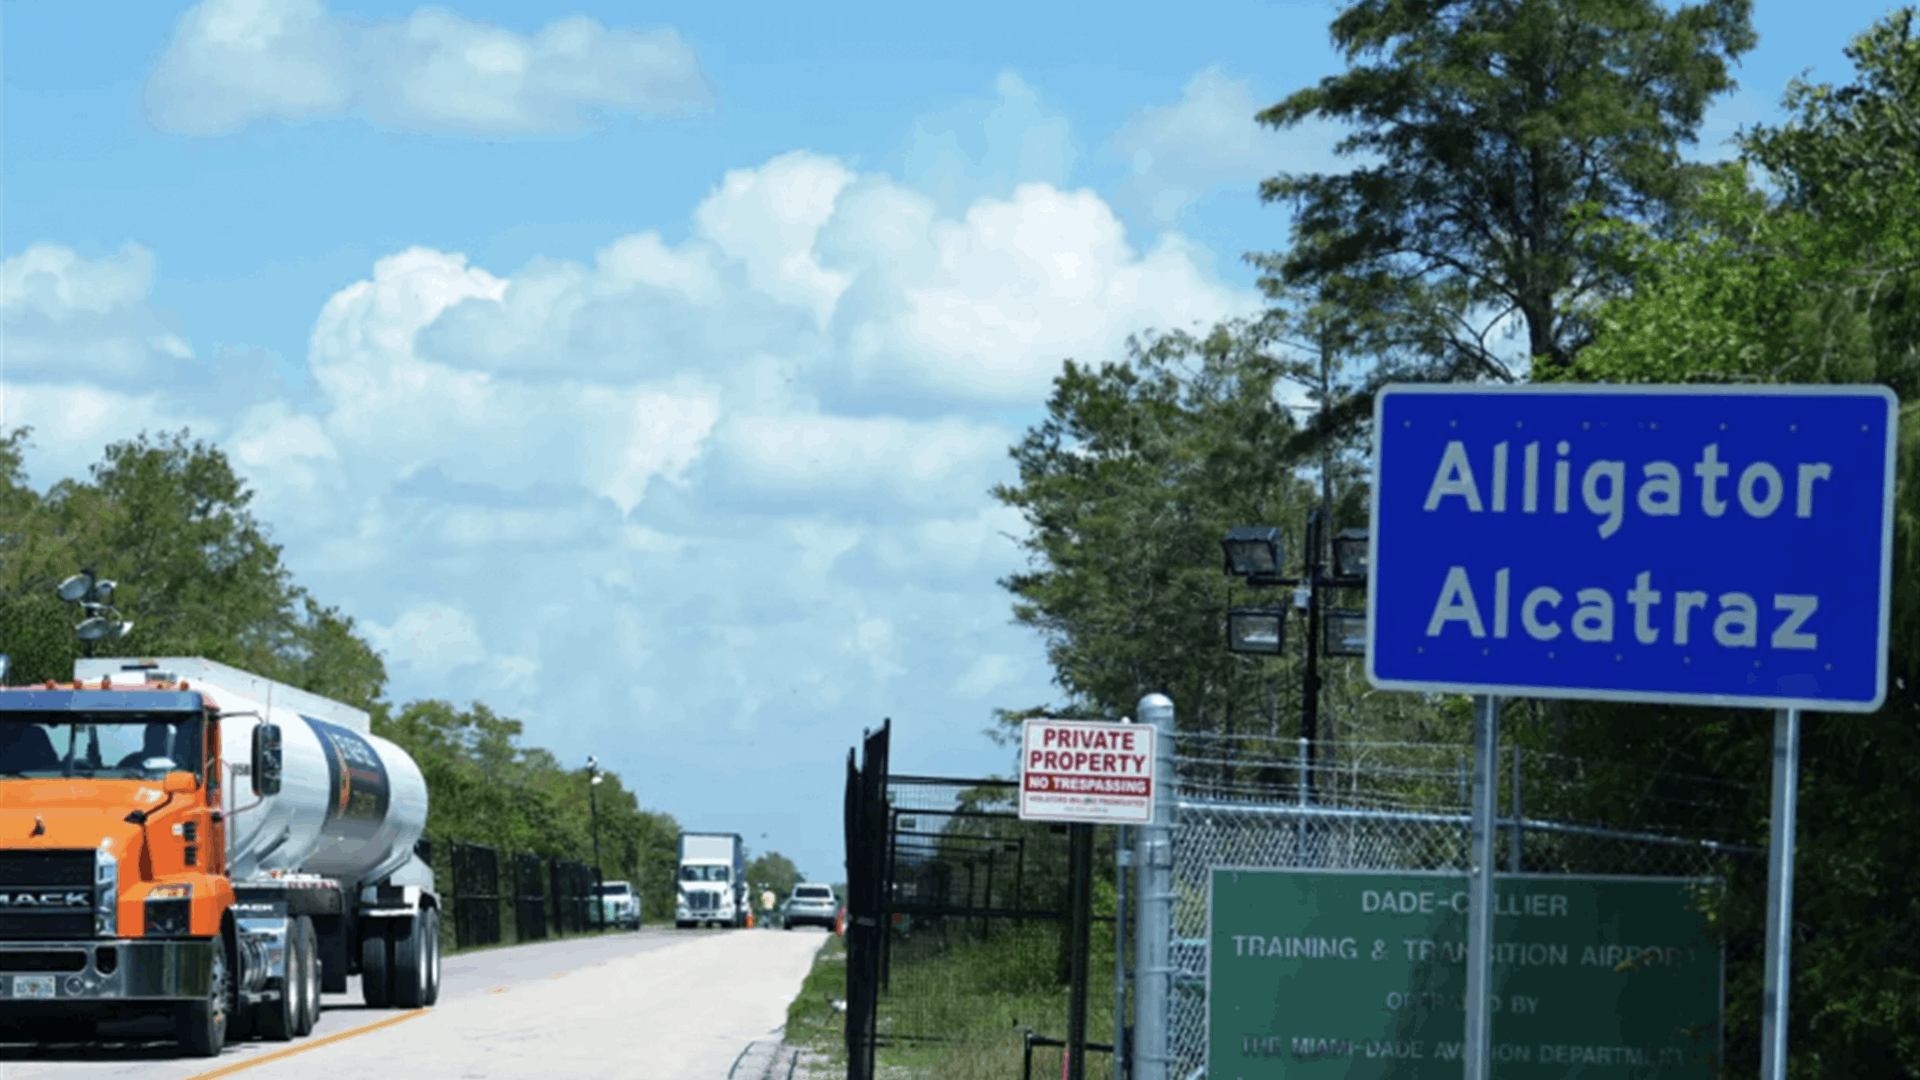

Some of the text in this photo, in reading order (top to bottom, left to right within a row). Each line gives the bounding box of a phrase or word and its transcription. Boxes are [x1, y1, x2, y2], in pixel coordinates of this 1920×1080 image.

[1424, 441, 1832, 539] Alligator
[1426, 566, 1819, 649] Alcatraz
[1043, 728, 1135, 751] PRIVATE
[1030, 750, 1147, 773] PROPERTY
[1028, 776, 1146, 794] NO TRESPASSING
[1362, 890, 1568, 917] DADE-CLLIER
[1231, 934, 1359, 960] TRAINING
[1370, 938, 1389, 961] &
[1511, 996, 1540, 1014] BY
